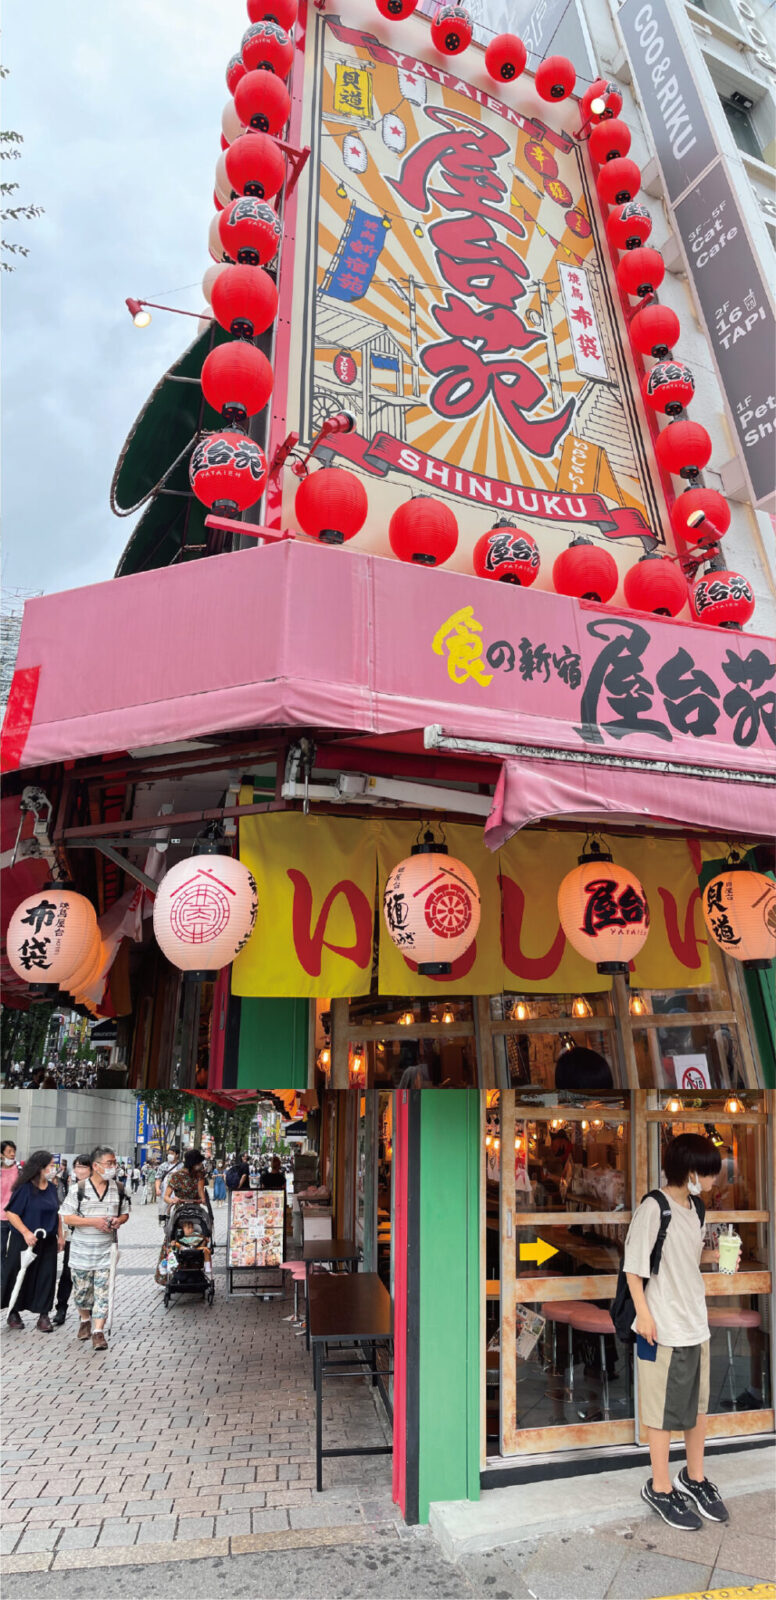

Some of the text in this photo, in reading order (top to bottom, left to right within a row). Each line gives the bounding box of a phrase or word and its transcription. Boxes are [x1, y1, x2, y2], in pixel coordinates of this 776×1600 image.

[388, 50, 526, 128] YATAIEN
[634, 4, 697, 160] COO&RIKU
[691, 219, 724, 253] Cat
[696, 226, 738, 269] Cafe
[384, 104, 575, 458] 屋台苑
[715, 300, 730, 320] 2F
[716, 306, 743, 336] 16
[719, 306, 767, 350] TAPI
[737, 394, 752, 414] 1F
[739, 395, 776, 430] Pet
[398, 448, 588, 518] SHINJUKU
[18, 899, 57, 970] 布袋
[707, 881, 742, 945] 貝道
